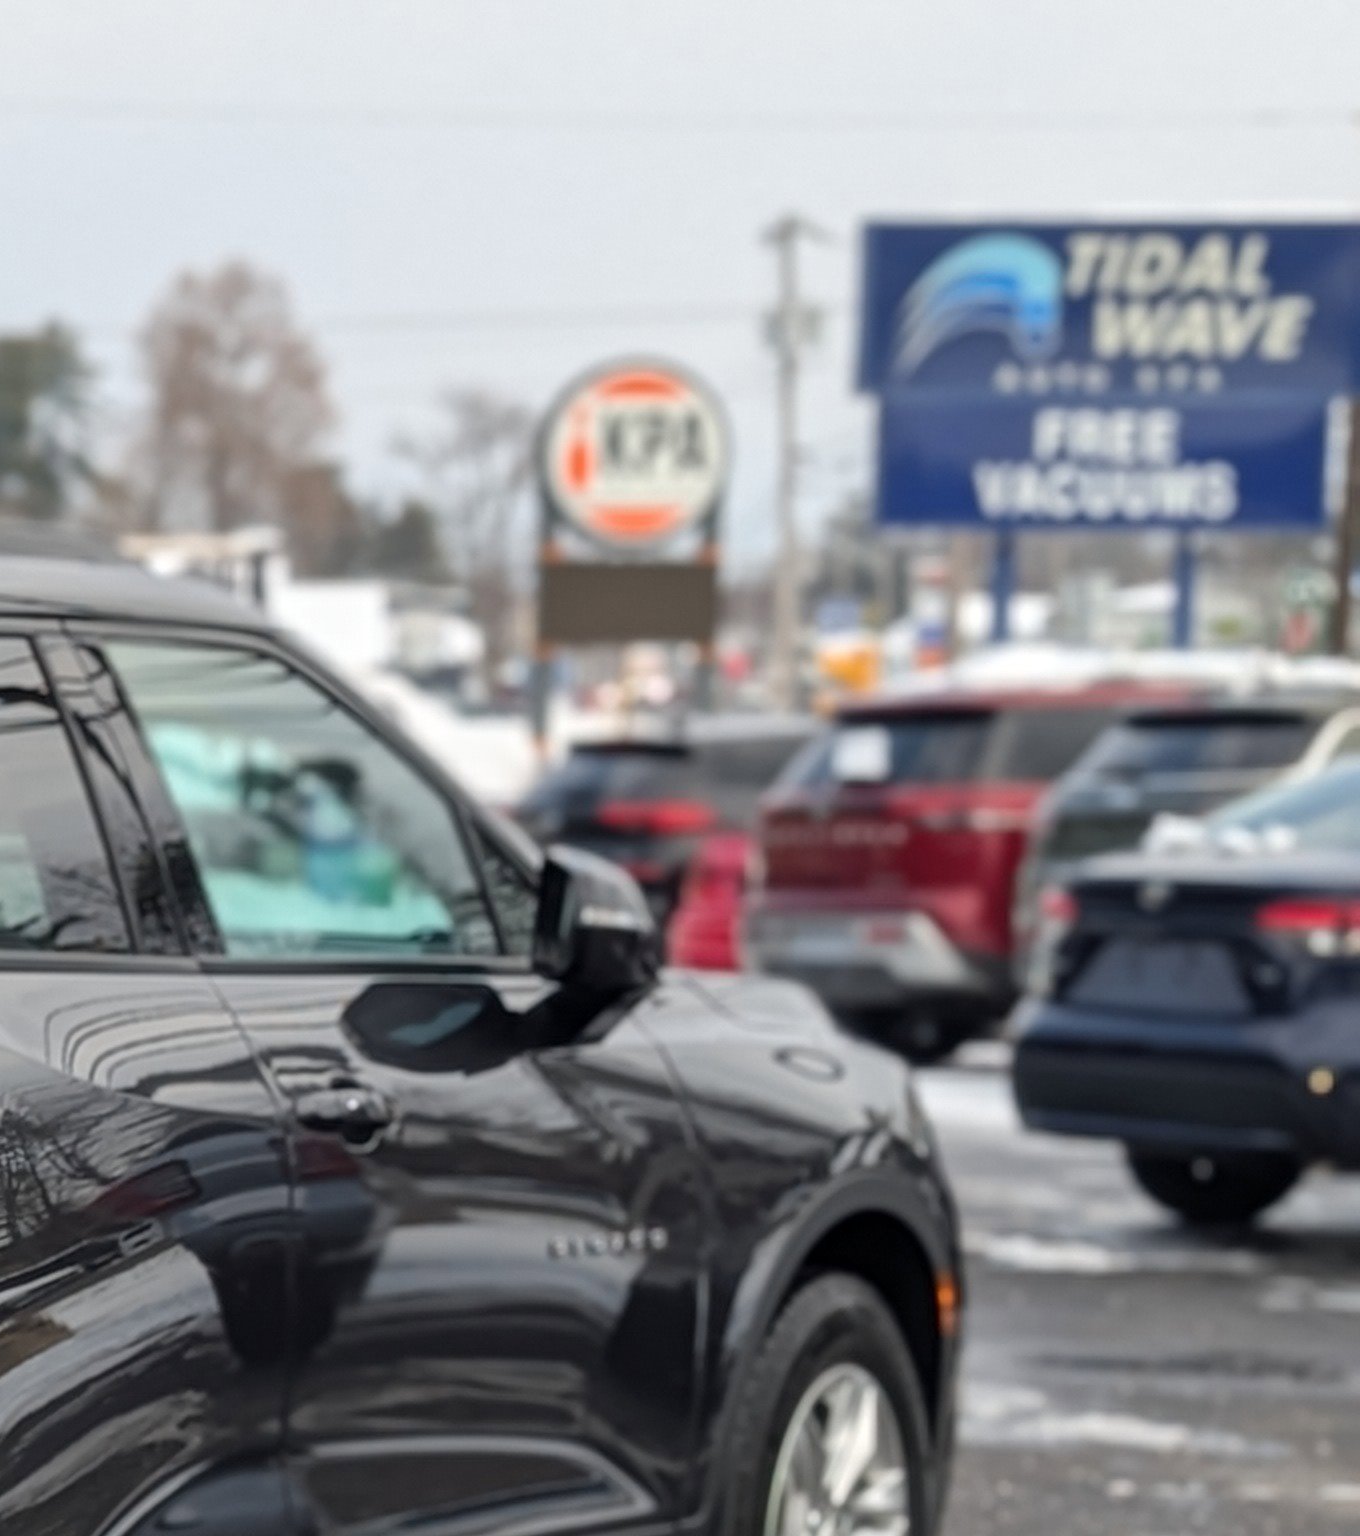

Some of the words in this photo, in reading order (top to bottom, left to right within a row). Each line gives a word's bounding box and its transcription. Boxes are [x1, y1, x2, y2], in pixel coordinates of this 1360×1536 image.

[1066, 231, 1270, 297] TIDAL
[1092, 295, 1312, 360] WAVE
[1033, 407, 1178, 461] FREE
[975, 462, 1237, 521] VACUUMS
